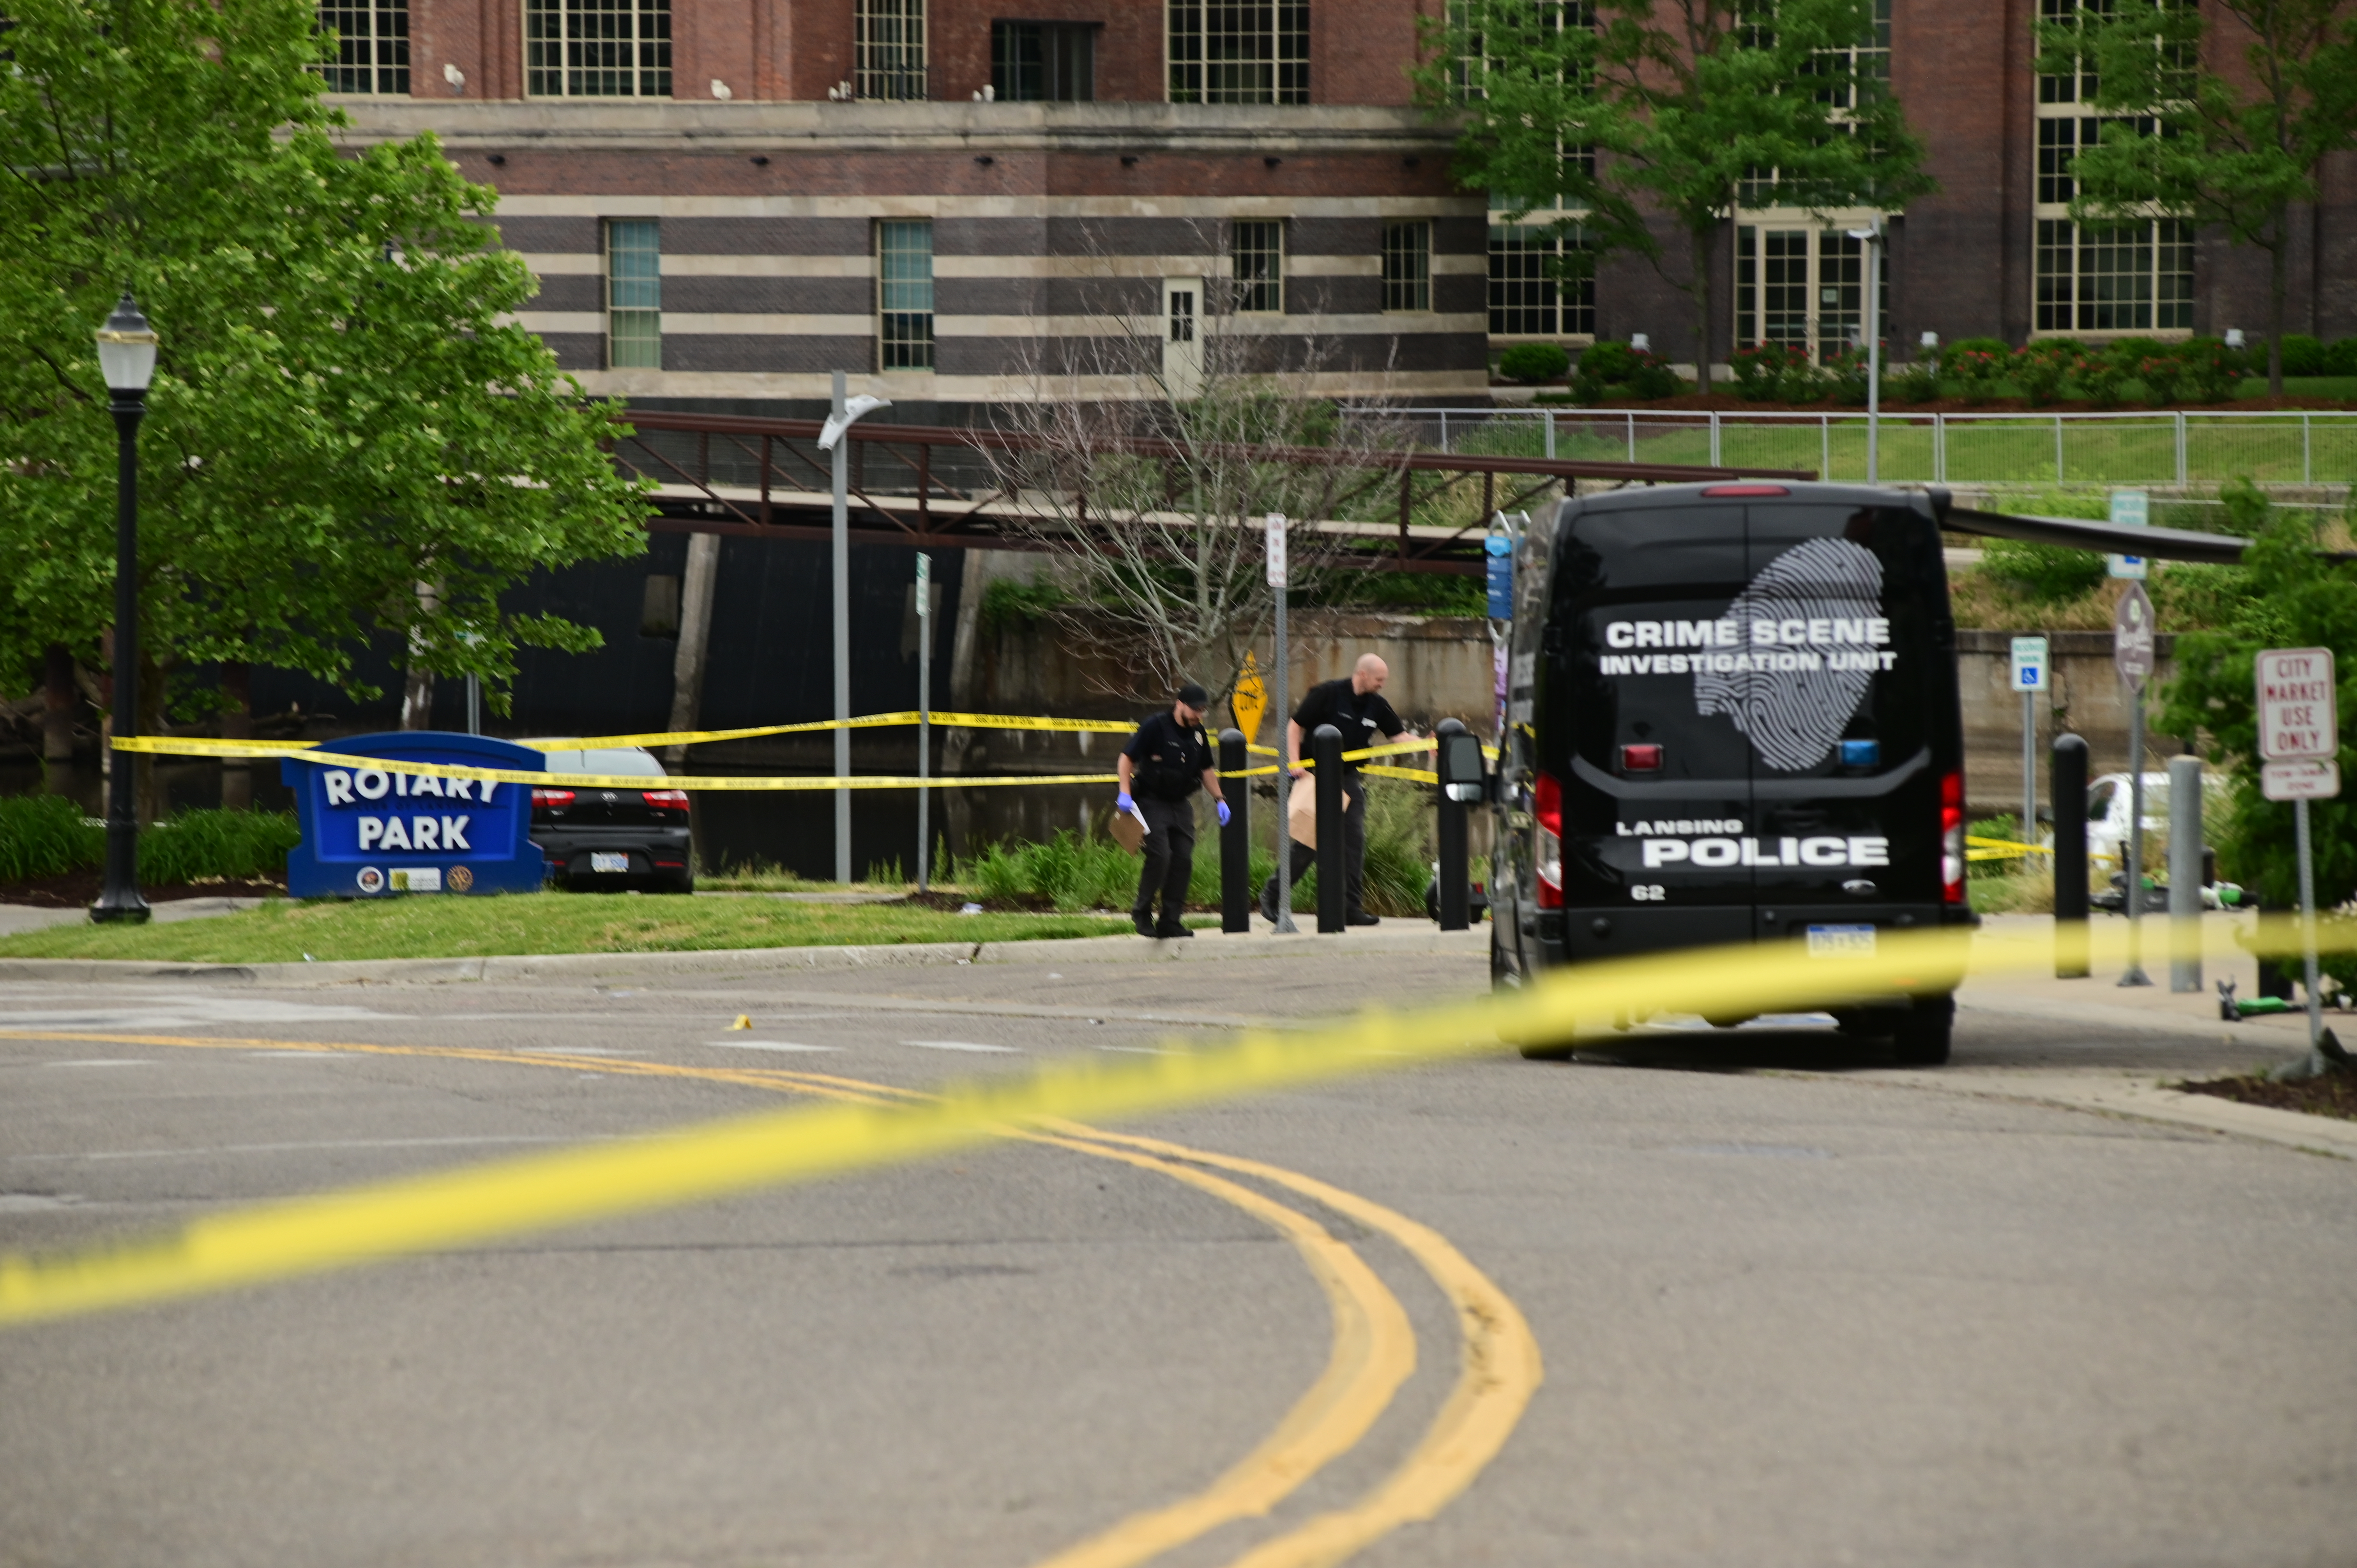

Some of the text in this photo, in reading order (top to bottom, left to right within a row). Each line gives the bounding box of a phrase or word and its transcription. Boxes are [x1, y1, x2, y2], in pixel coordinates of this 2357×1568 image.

[1606, 618, 1891, 648] CRIME SCENE
[1600, 652, 1897, 675] INVESTIGATION UNIT
[2277, 658, 2313, 678] CITY
[2266, 681, 2327, 701] MARKET
[2280, 706, 2314, 726] USE
[2277, 730, 2321, 750] ONLY
[358, 815, 471, 850] PARK
[1616, 819, 1743, 836] LANSING
[1643, 837, 1889, 867] POLICE
[1631, 885, 1666, 901] 62
